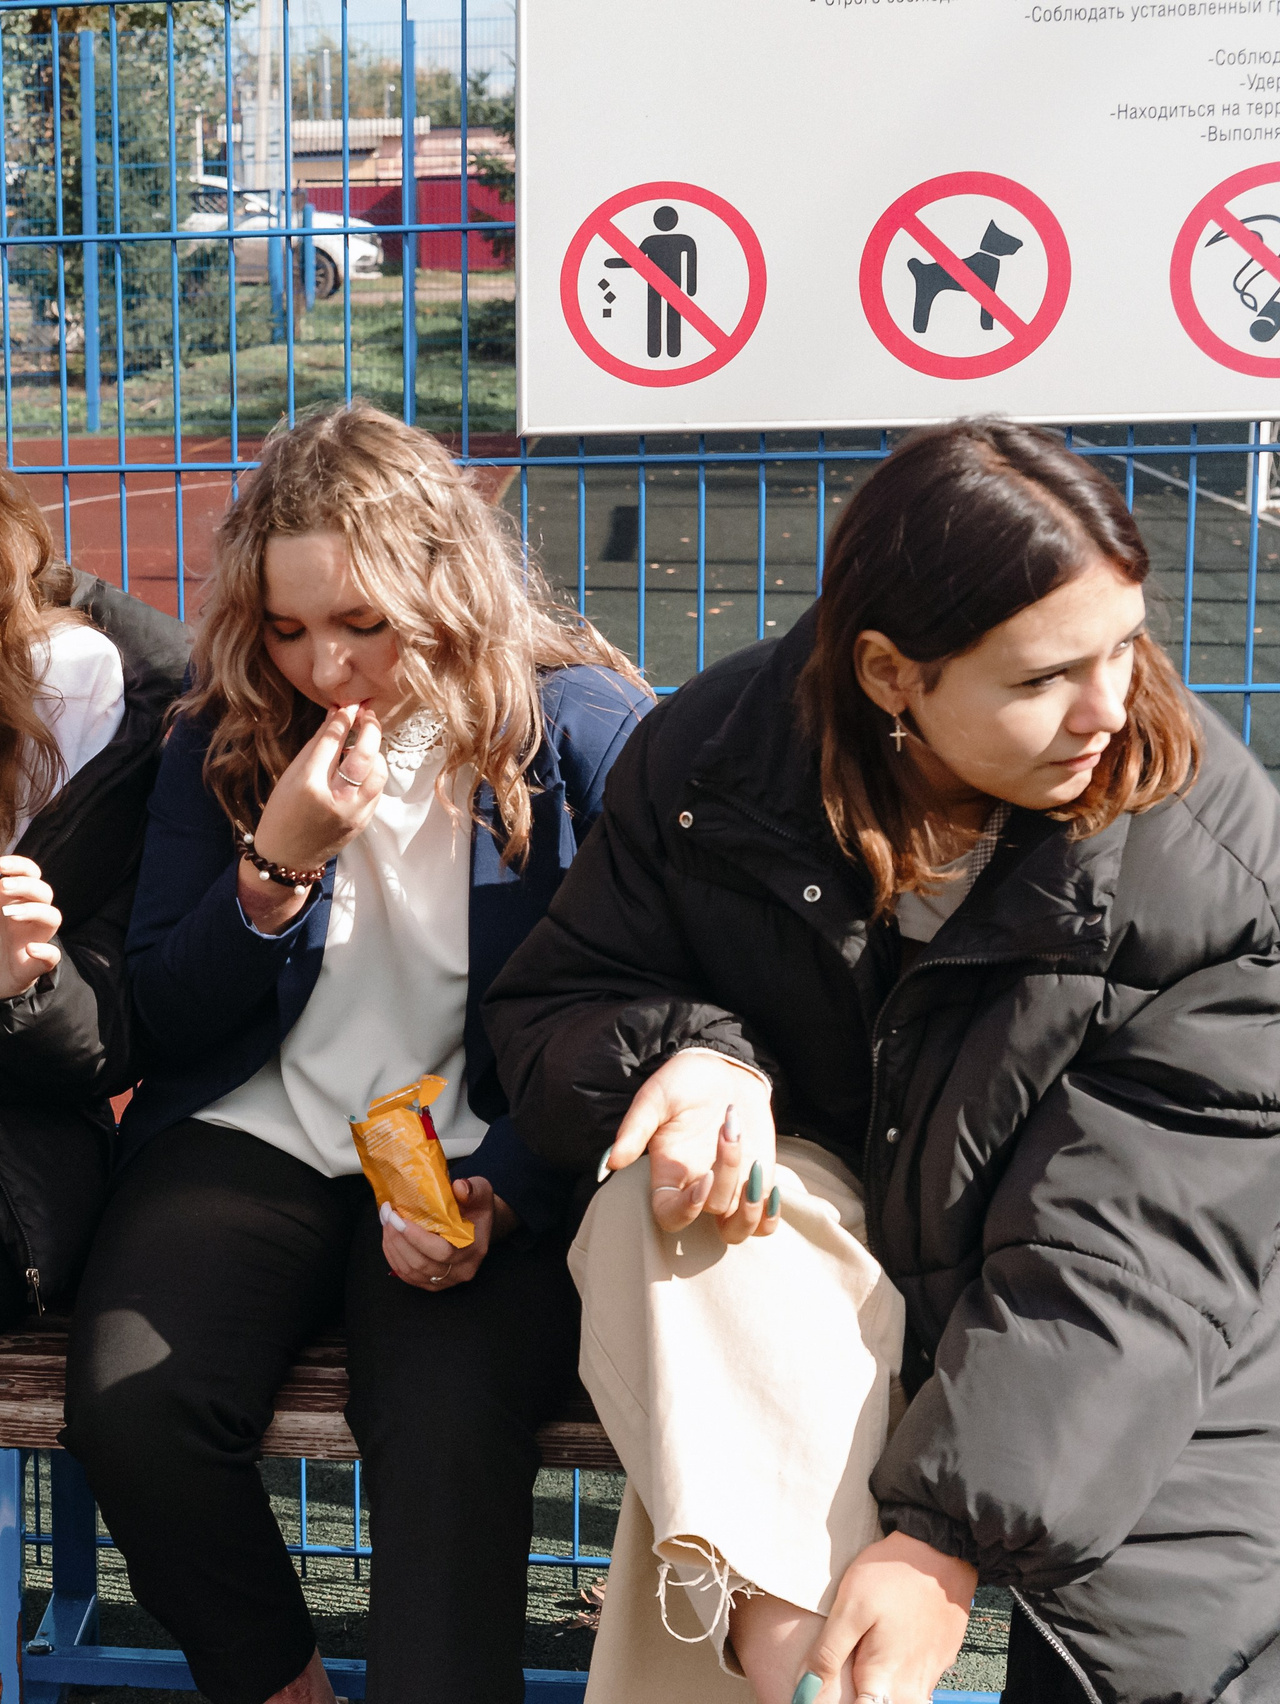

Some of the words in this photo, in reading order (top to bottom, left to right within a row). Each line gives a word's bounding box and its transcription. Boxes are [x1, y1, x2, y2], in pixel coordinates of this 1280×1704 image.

[1024, 5, 1125, 23] -Соблюдать
[1130, 0, 1262, 22] установленный
[1208, 48, 1280, 66] -Соблюд
[1109, 103, 1215, 121] -Находиться
[1221, 103, 1240, 117] на
[1200, 125, 1280, 142] -Выполня
